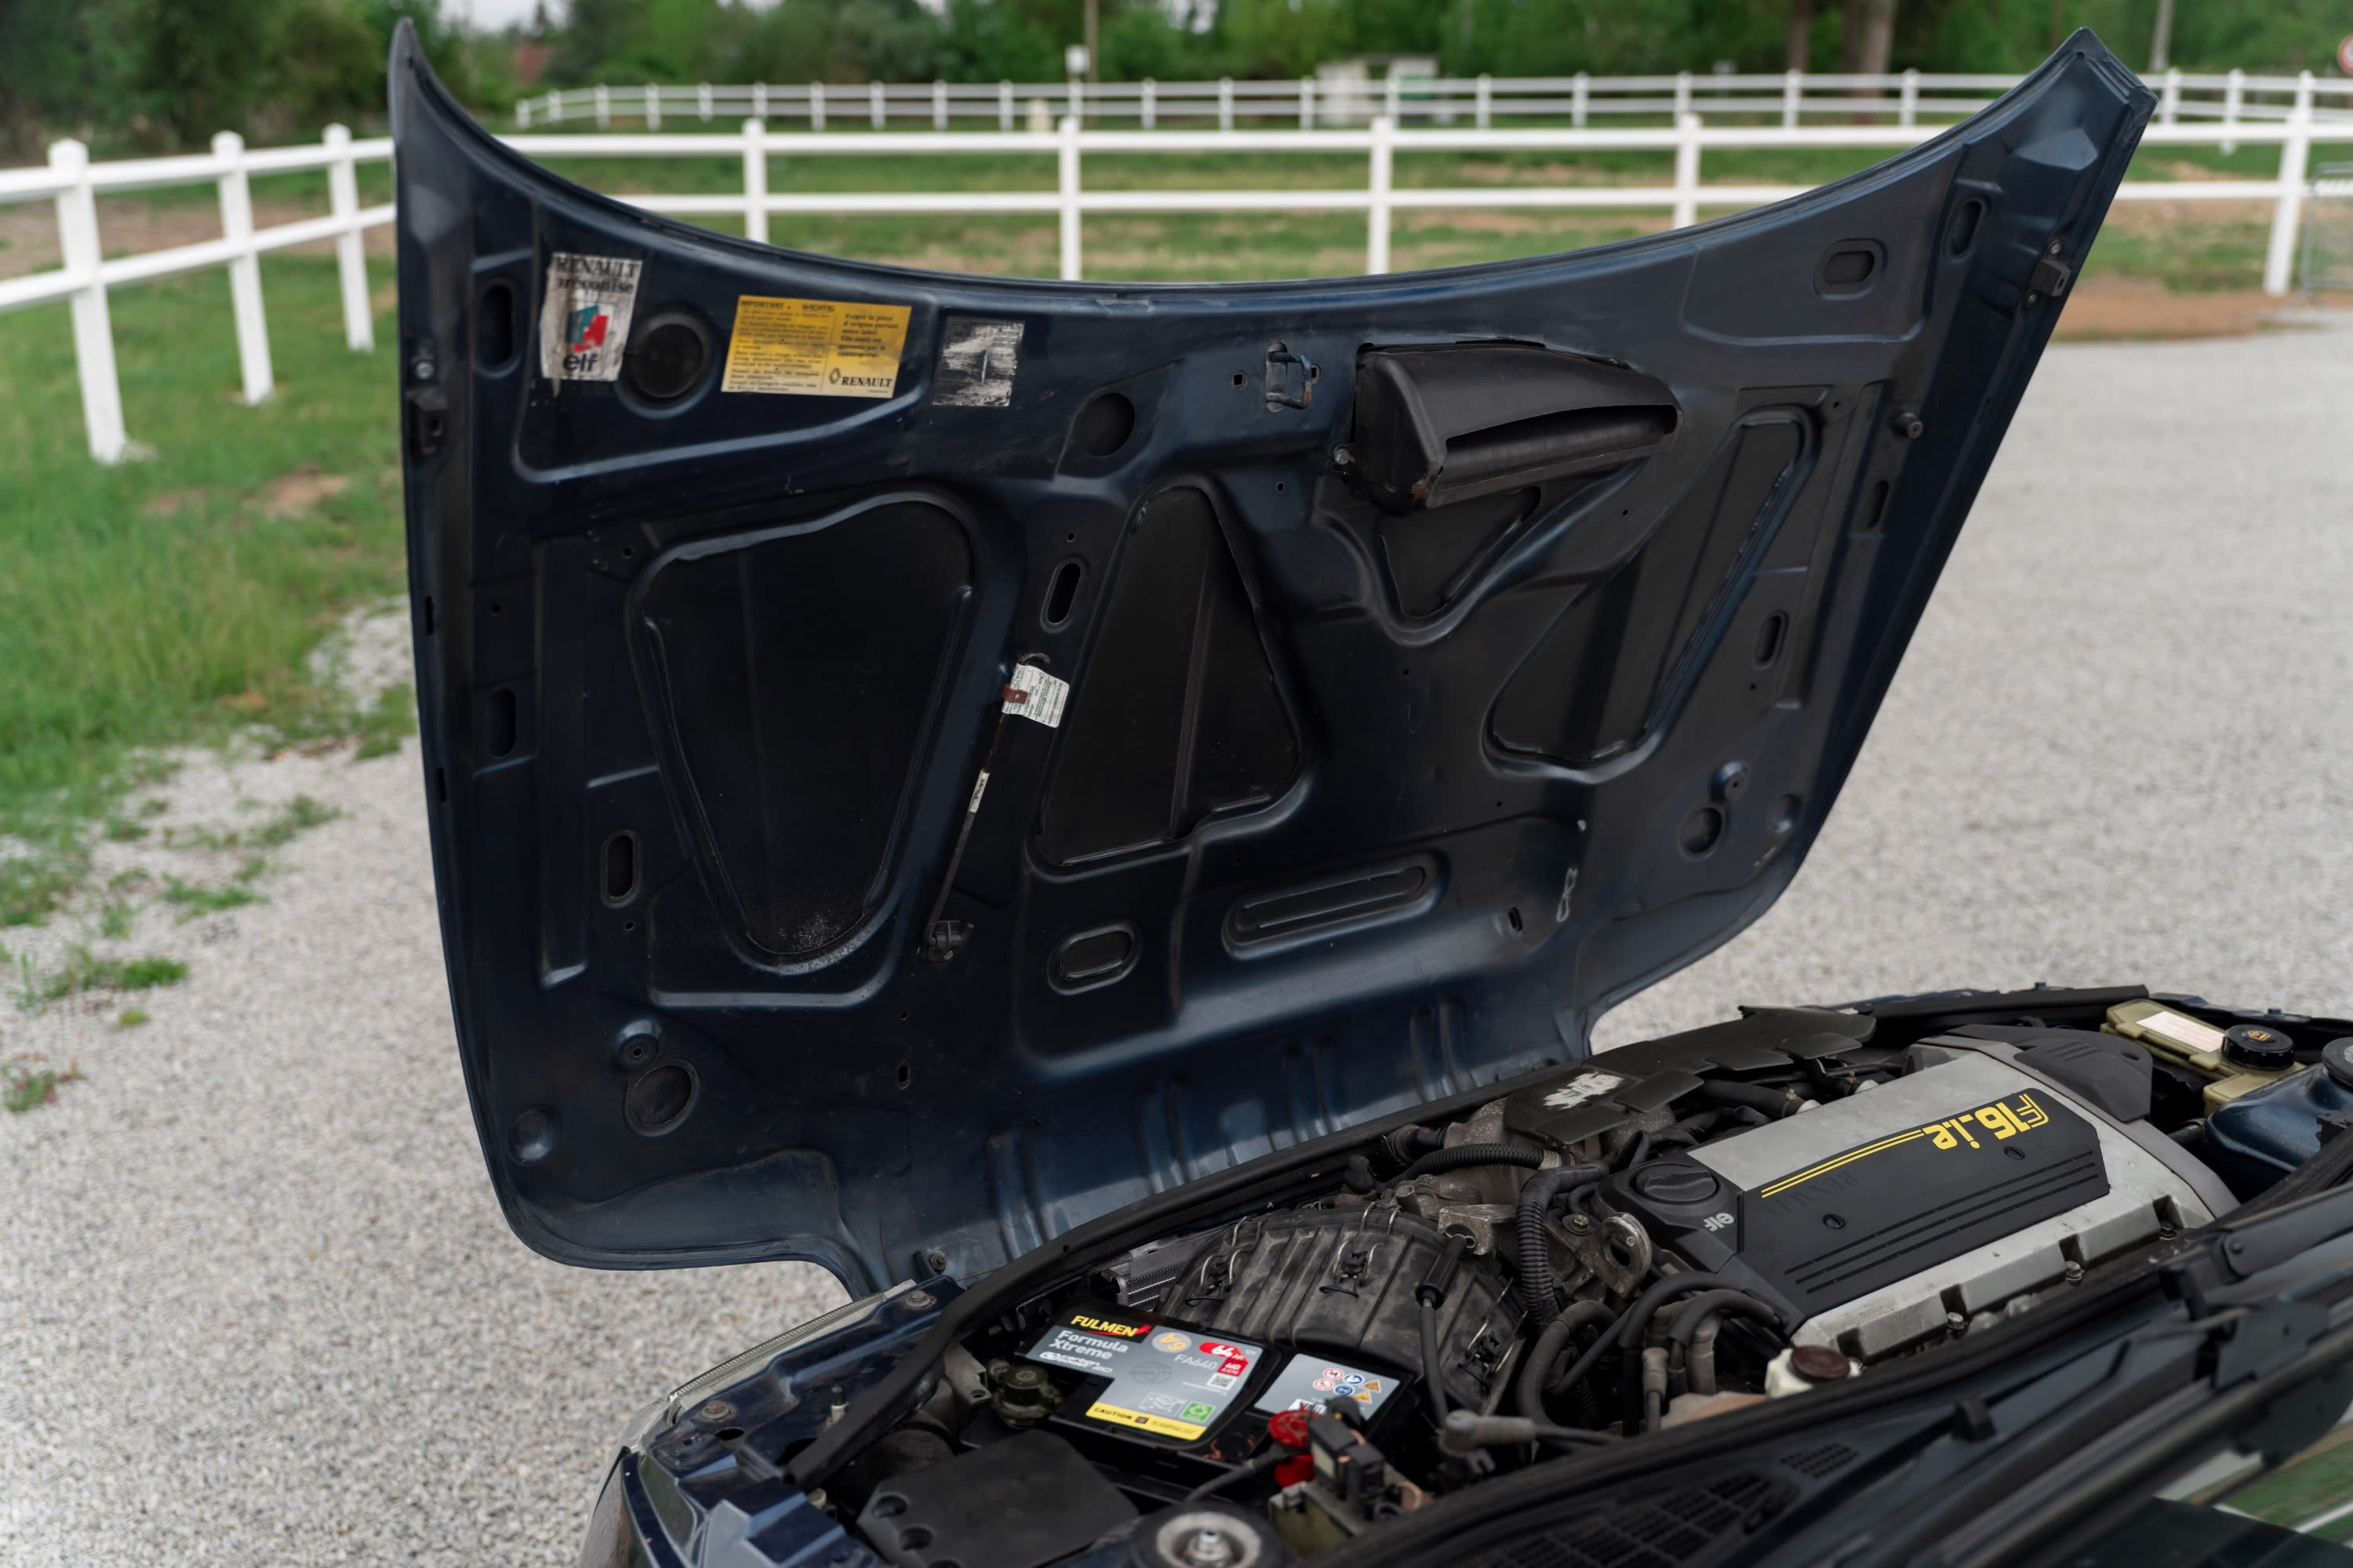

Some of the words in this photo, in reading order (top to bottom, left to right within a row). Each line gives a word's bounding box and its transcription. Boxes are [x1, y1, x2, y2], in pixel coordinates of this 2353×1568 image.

[562, 353, 598, 373] elf
[842, 377, 893, 387] RENAULT
[1703, 1213, 1734, 1232] elf
[1071, 1315, 1138, 1337] FULMEN
[1048, 1338, 1114, 1359] Xtreme
[1057, 1330, 1129, 1353] Formula
[1211, 1344, 1234, 1358] 64
[1174, 1354, 1218, 1370] FA640
[1094, 1407, 1133, 1421] CAUTION
